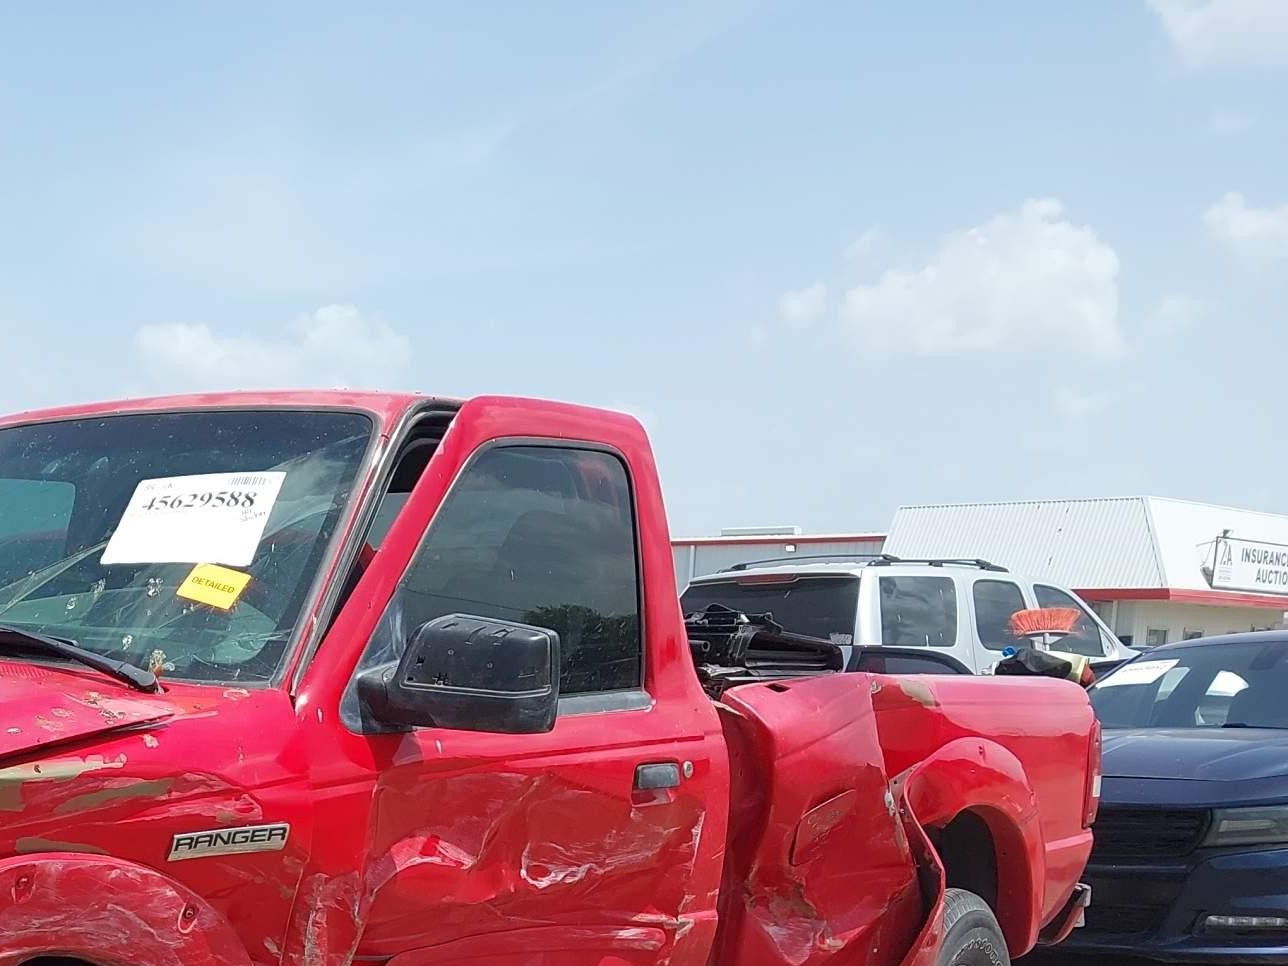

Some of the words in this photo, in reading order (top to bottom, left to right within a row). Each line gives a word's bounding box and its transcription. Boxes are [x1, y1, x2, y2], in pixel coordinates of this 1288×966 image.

[141, 490, 258, 511] 45629588
[1241, 547, 1288, 568] INSURANC
[191, 576, 236, 594] DETAILED
[173, 827, 288, 852] RANGER
